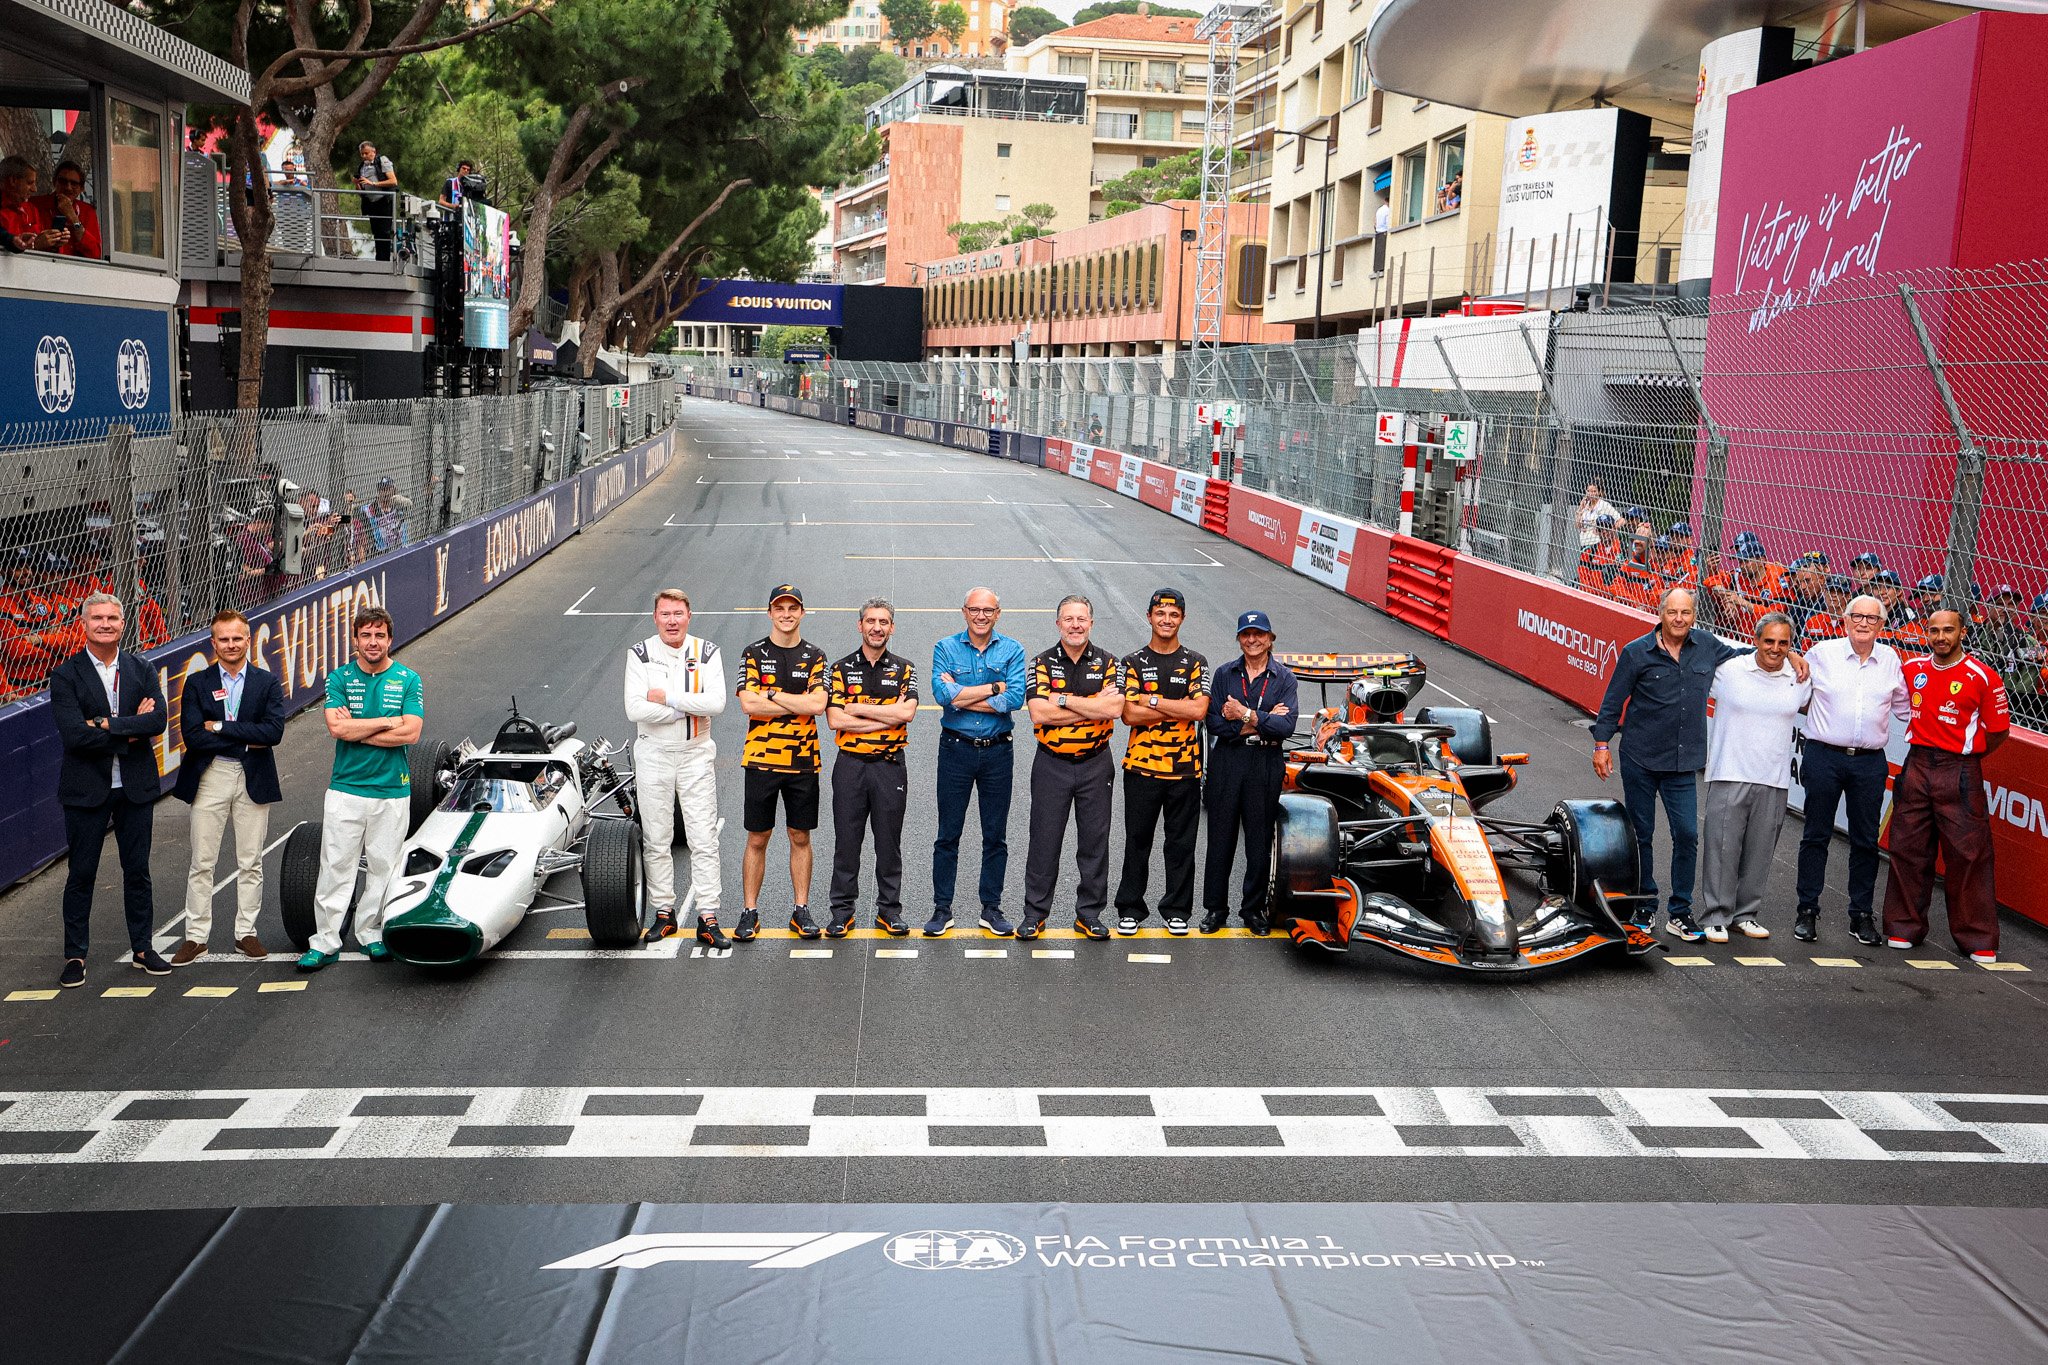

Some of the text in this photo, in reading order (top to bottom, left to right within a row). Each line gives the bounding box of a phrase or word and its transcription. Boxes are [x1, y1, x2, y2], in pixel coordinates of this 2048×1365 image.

[1522, 182, 1545, 191] TRAVELS
[1546, 181, 1554, 189] IN
[1521, 190, 1553, 201] VUITTON
[1735, 124, 1922, 296] Victory is better
[1807, 200, 1892, 308] shared
[734, 295, 832, 311] LOUIS VUITTON
[487, 494, 556, 584] LOUIS VUITTON
[1567, 654, 1598, 676] SINCE 1929
[1034, 1235, 1345, 1252] FIA Formula 1
[1037, 1251, 1177, 1268] World
